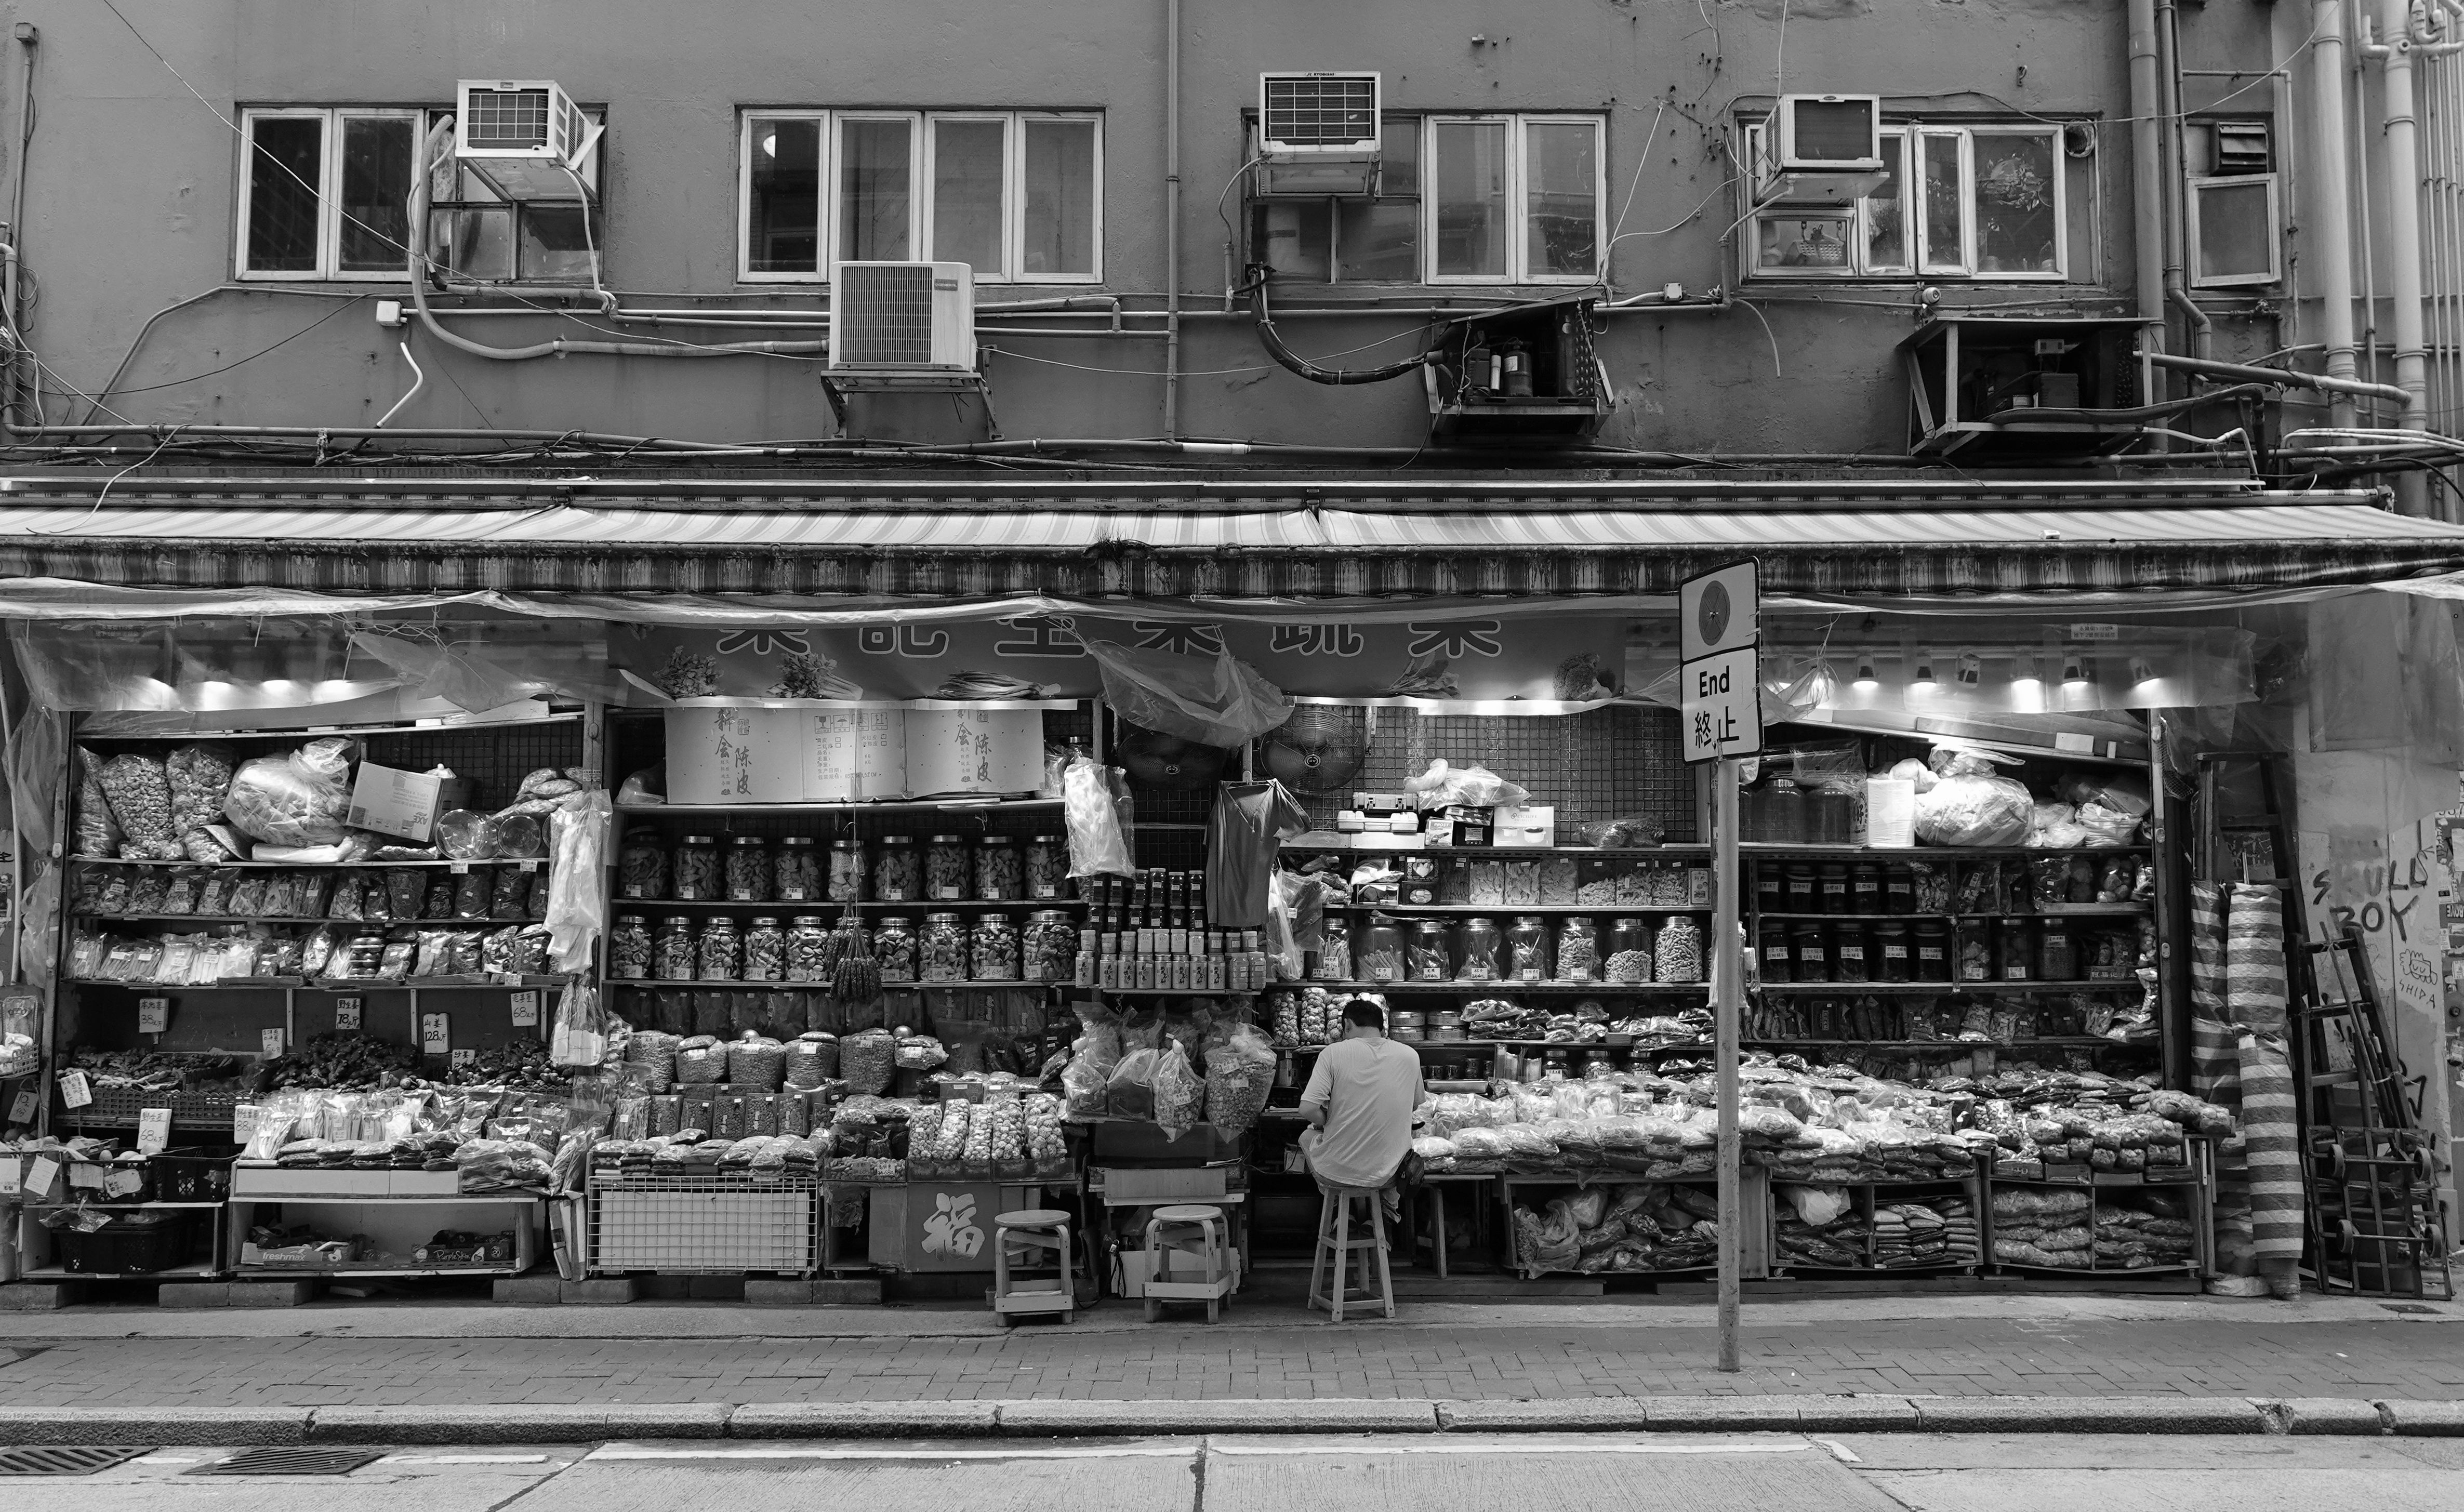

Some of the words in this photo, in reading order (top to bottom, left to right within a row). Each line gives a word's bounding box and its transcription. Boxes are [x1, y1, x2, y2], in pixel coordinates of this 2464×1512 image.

[1700, 665, 1729, 698] End
[1695, 706, 1740, 749] 終止
[2329, 895, 2419, 944] BOY
[2400, 979, 2436, 1009] SHIDA
[921, 1192, 986, 1262] 福
[262, 1251, 307, 1261] freshmax
